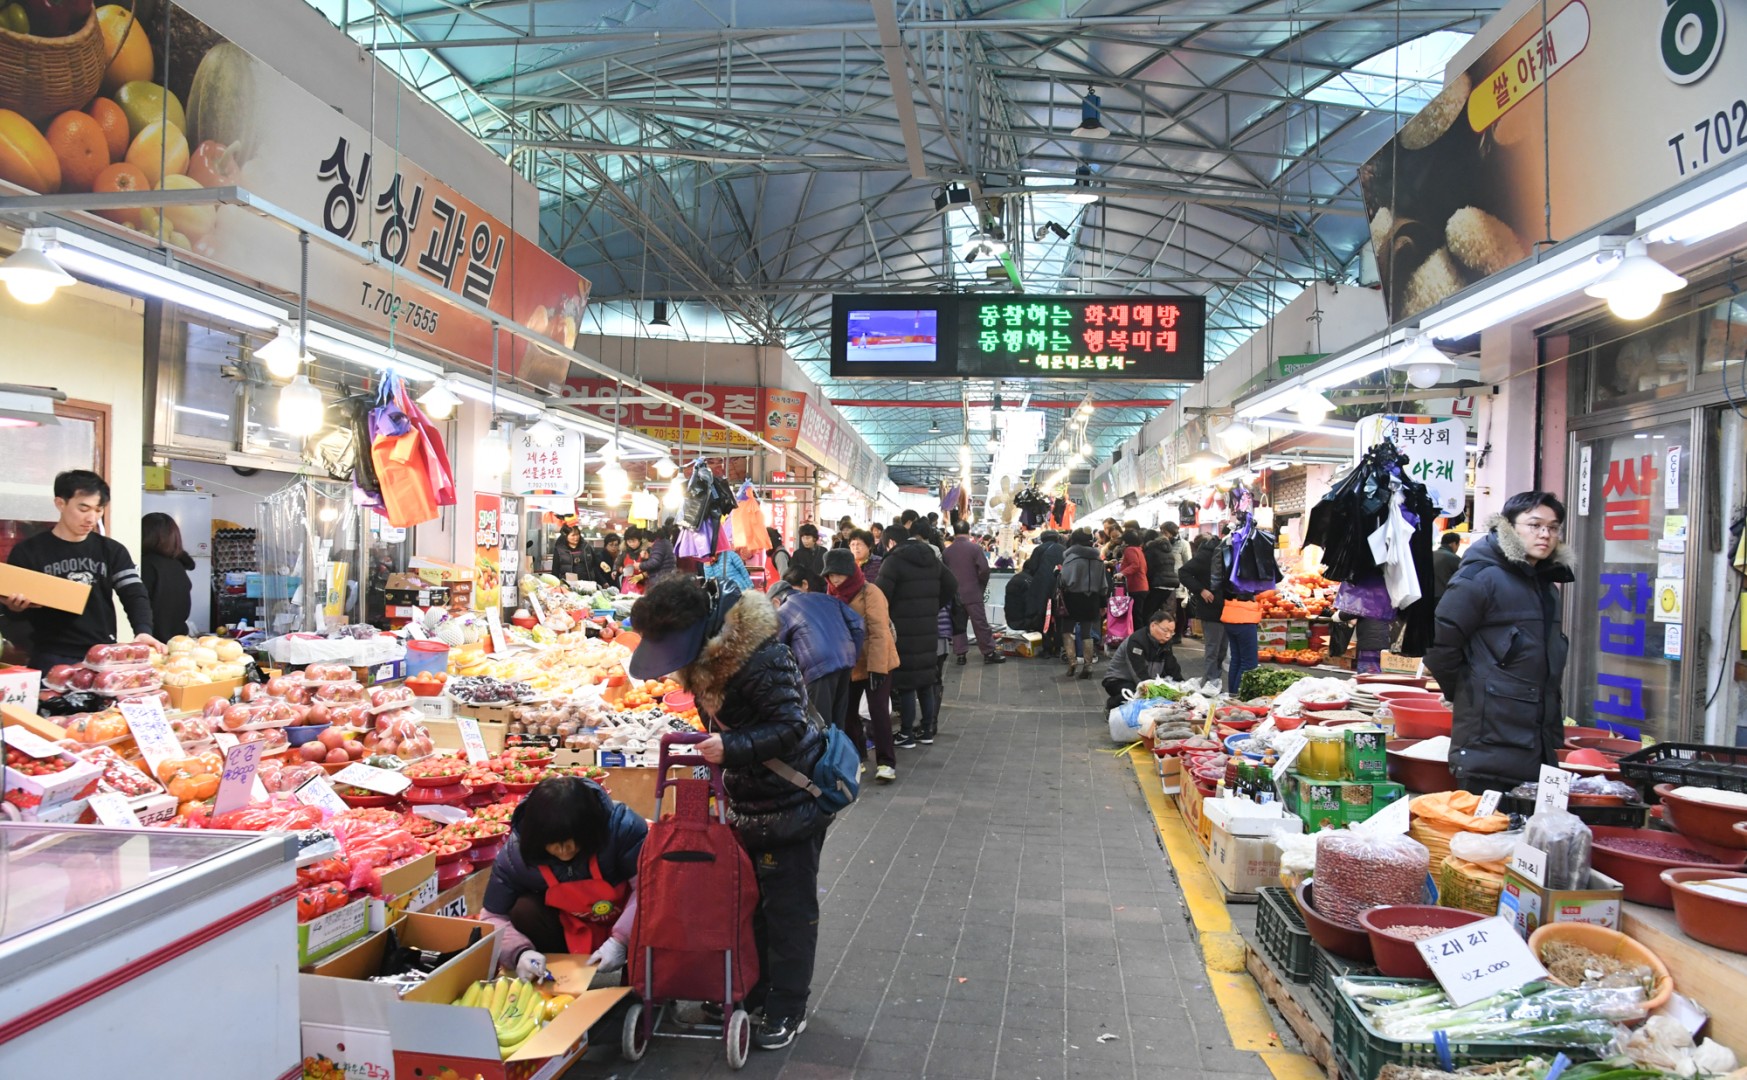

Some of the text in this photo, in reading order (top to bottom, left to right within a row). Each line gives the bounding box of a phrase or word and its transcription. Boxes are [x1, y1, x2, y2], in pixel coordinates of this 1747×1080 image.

[318, 137, 504, 308] 싱싱과일
[362, 282, 438, 333] T.702-7555
[979, 304, 1180, 328] 동참하는 화재예방
[978, 329, 1177, 352] 동행하는 행복미래
[522, 435, 565, 448] 싱일
[527, 450, 559, 466] 제수용
[1412, 458, 1454, 482] 야채
[1669, 454, 1678, 486] CCTV
[1602, 453, 1658, 541] 쌀
[478, 509, 497, 533] 과일
[1441, 930, 1488, 956] 대파
